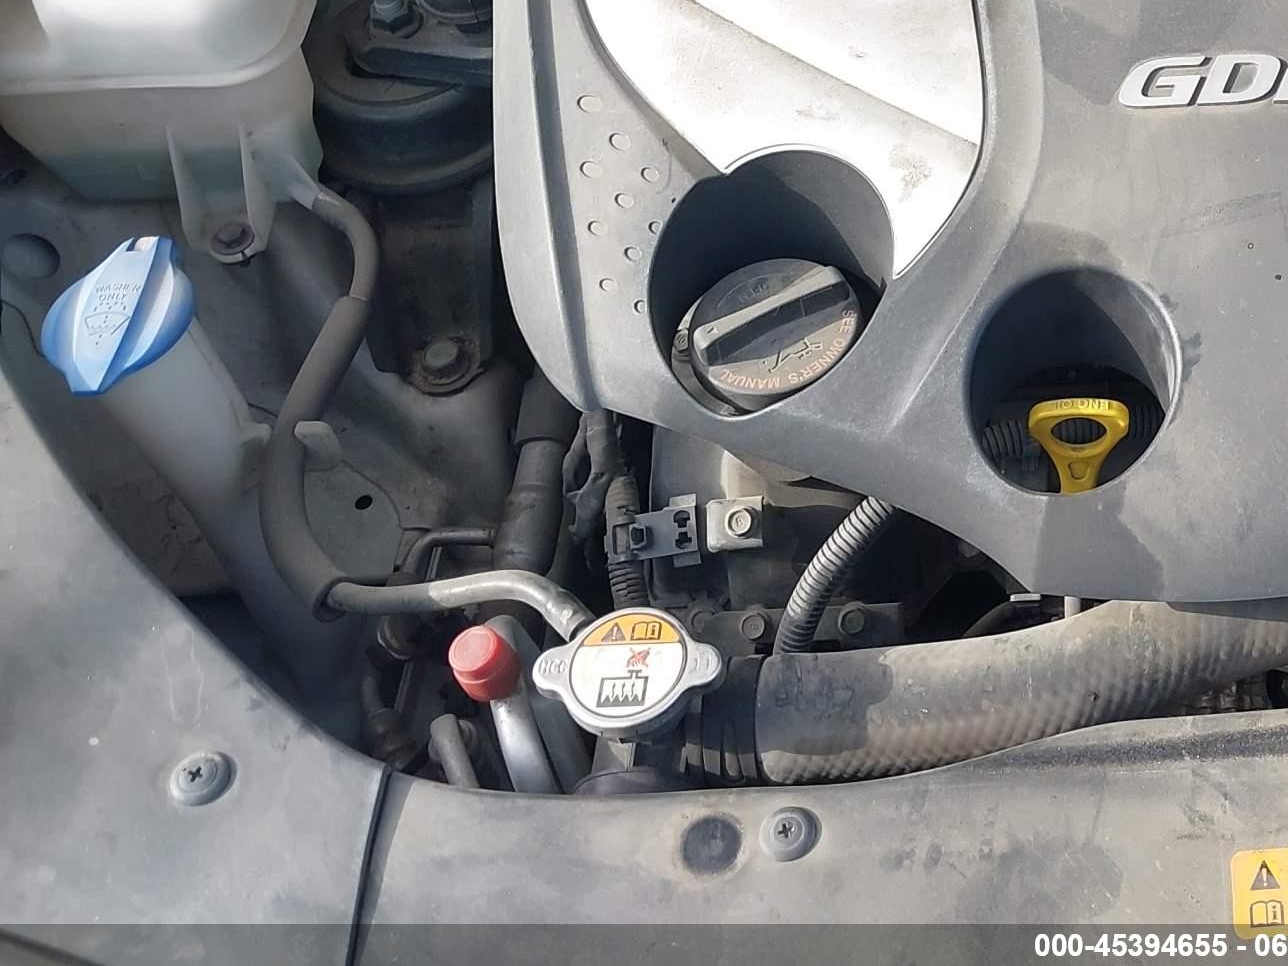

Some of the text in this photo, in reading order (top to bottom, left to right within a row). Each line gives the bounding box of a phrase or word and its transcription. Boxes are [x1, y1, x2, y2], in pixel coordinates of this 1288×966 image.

[95, 282, 141, 293] WASHER
[99, 293, 128, 302] ONLY
[720, 309, 857, 389] SEE OWNER'S MANUAL
